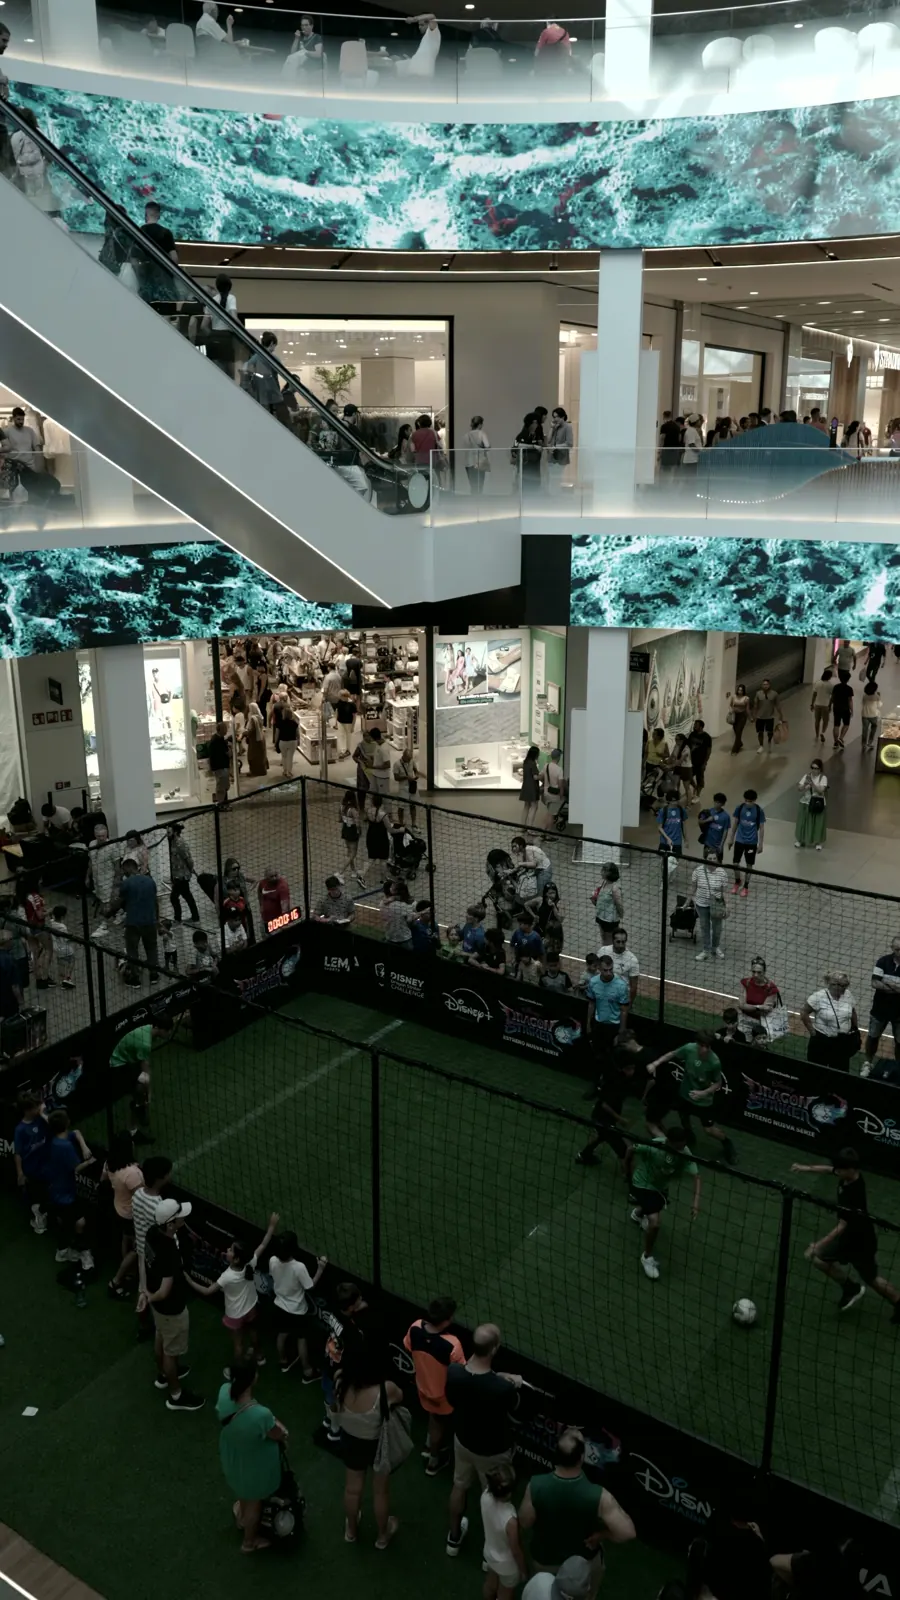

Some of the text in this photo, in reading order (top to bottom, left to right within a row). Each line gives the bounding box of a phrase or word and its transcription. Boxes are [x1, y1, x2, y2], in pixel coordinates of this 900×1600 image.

[390, 971, 425, 988] DISNEY
[390, 983, 425, 999] CHALLENGE
[741, 1072, 820, 1110] DRAGON
[743, 1110, 816, 1138] ESTRENO NUEVA SERIE
[523, 1448, 554, 1470] NUEVA
